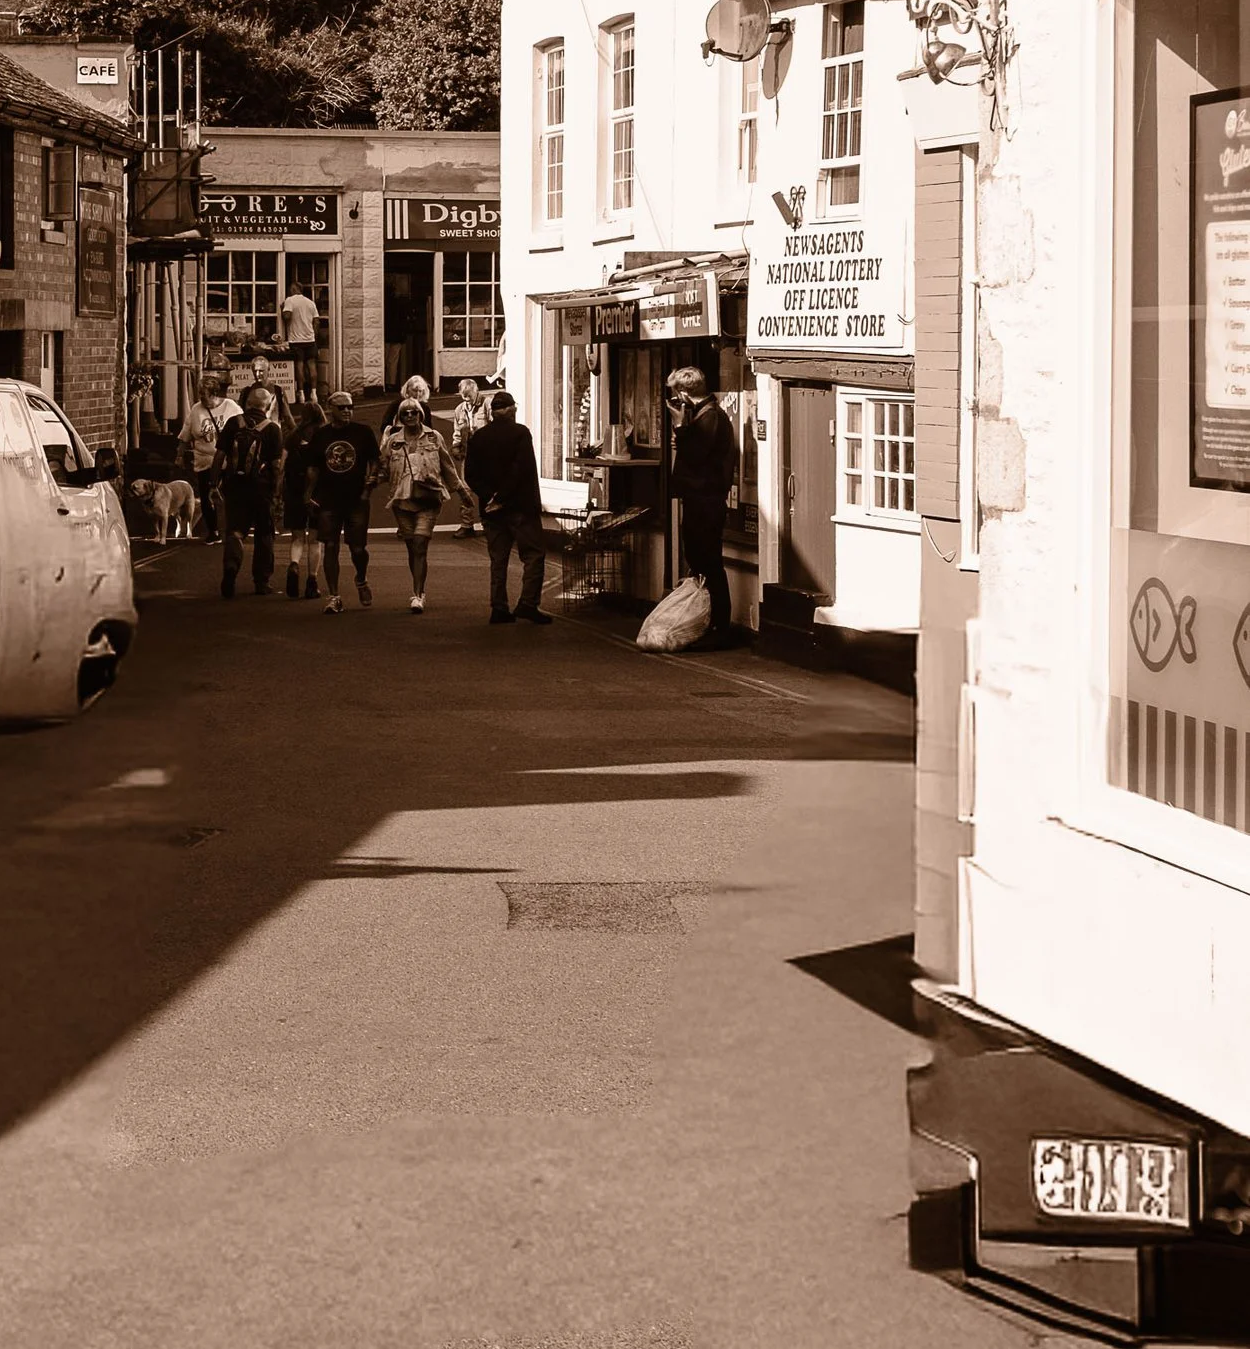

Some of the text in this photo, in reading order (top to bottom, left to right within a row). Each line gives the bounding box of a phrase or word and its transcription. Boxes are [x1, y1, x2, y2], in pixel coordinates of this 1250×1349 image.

[78, 61, 116, 78] CAFÉ
[224, 215, 231, 224] &
[234, 215, 309, 224] VEGETABLES
[439, 229, 474, 238] SWEET
[784, 230, 864, 257] NEWSAGENTS
[766, 258, 883, 285] NATIONAL LOTTERY
[784, 287, 859, 311] OFF LICENCE
[595, 300, 636, 336] Premier
[758, 314, 886, 337] CONVENIENCE STORE
